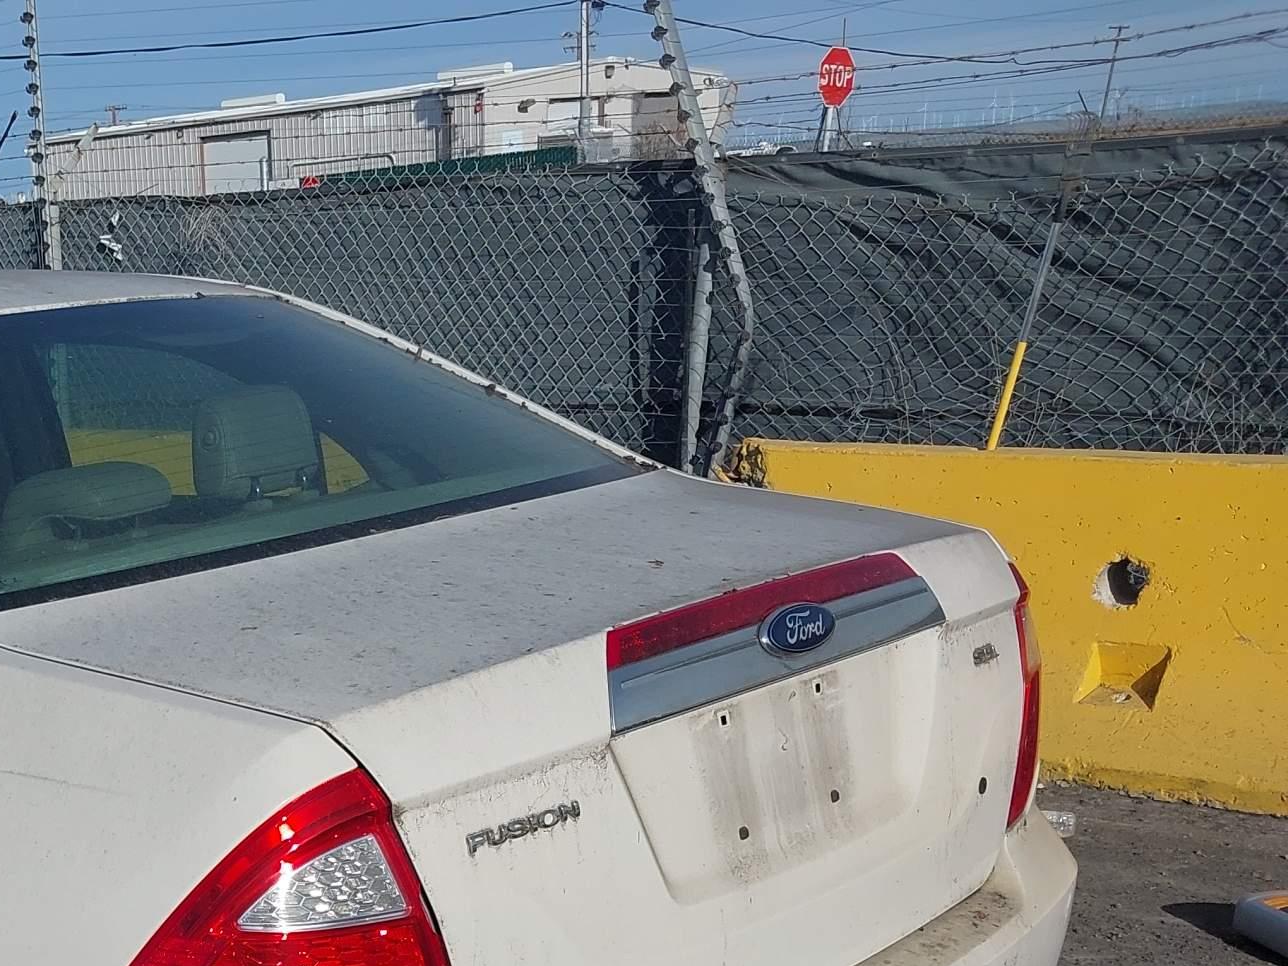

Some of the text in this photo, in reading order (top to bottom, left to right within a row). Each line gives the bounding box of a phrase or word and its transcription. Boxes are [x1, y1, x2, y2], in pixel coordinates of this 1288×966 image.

[820, 63, 853, 88] STOP
[786, 609, 825, 644] Ford
[465, 799, 581, 856] FUSION
